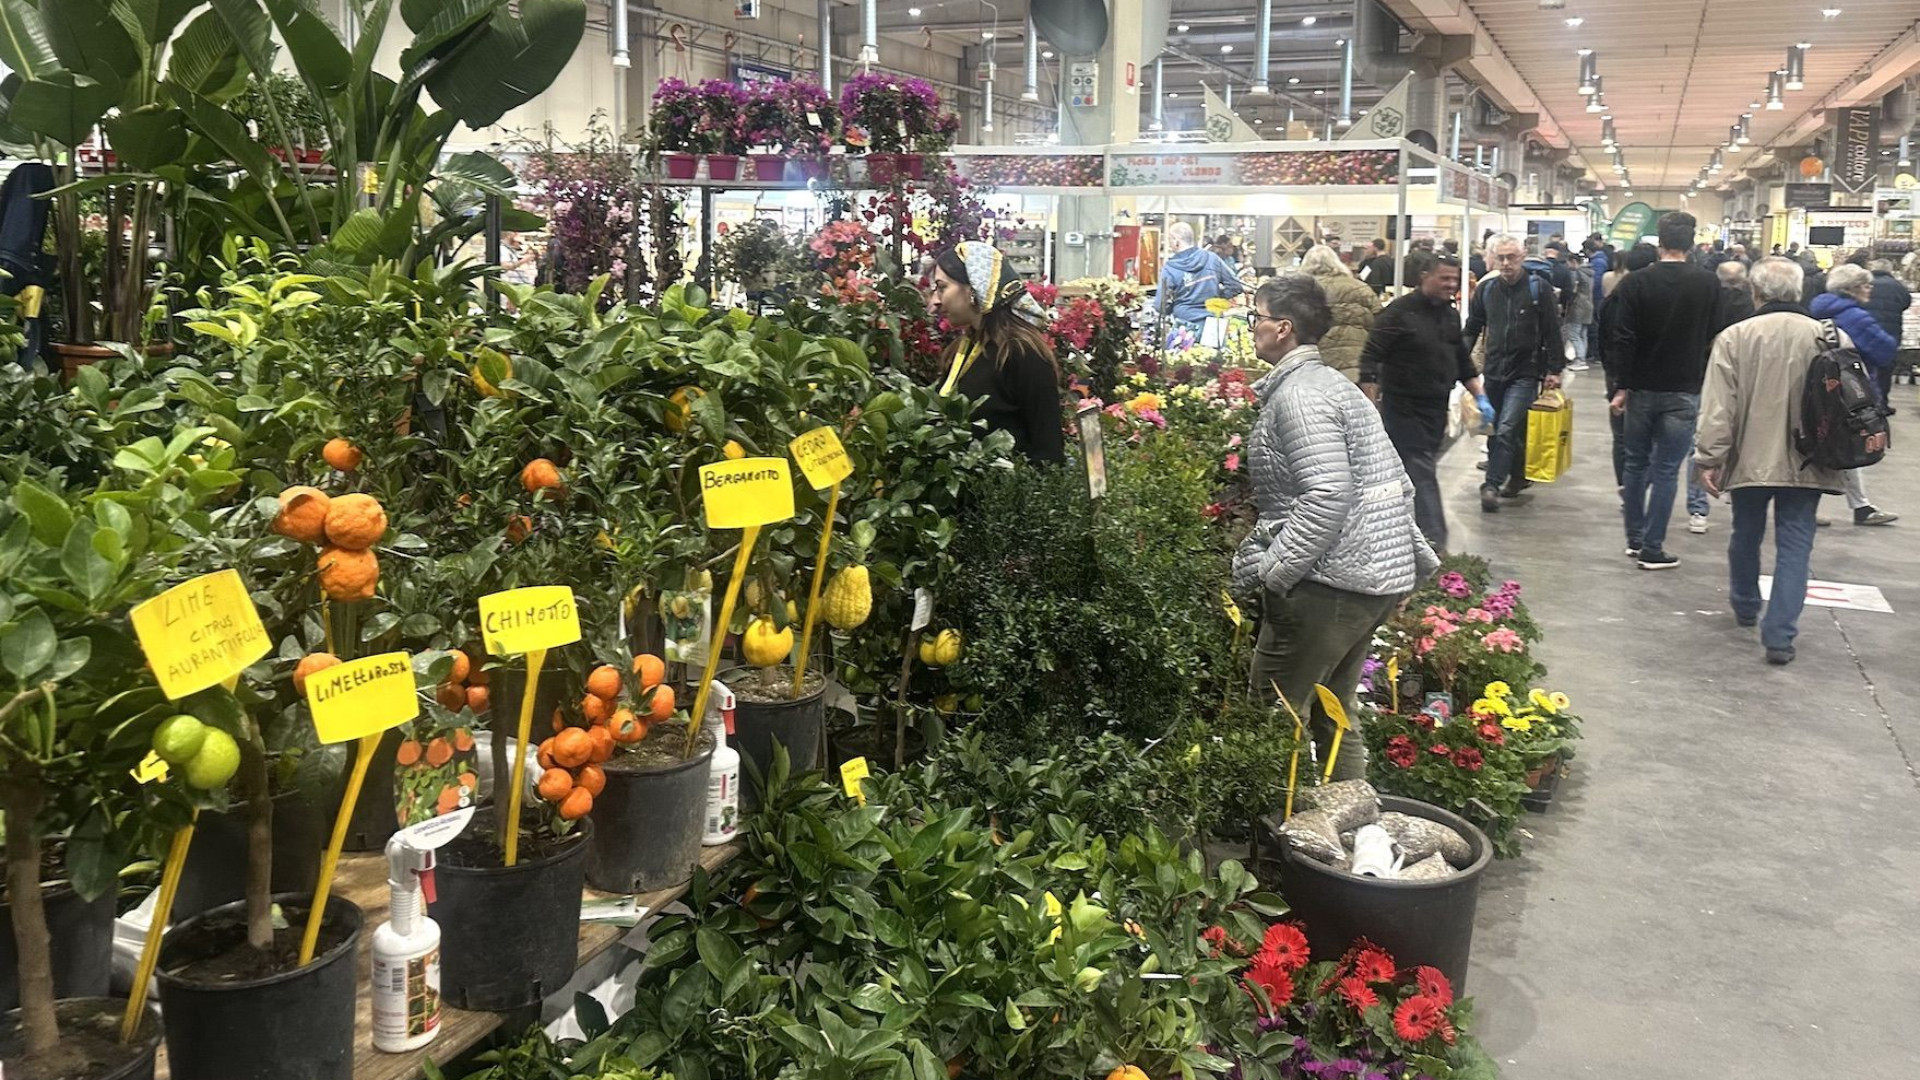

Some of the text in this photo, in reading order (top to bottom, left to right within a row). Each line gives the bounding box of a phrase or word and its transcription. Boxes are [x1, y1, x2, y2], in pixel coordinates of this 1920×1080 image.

[704, 469, 780, 490] BERGAMOTTO
[166, 584, 215, 628] LIME
[190, 614, 233, 643] CITRUS
